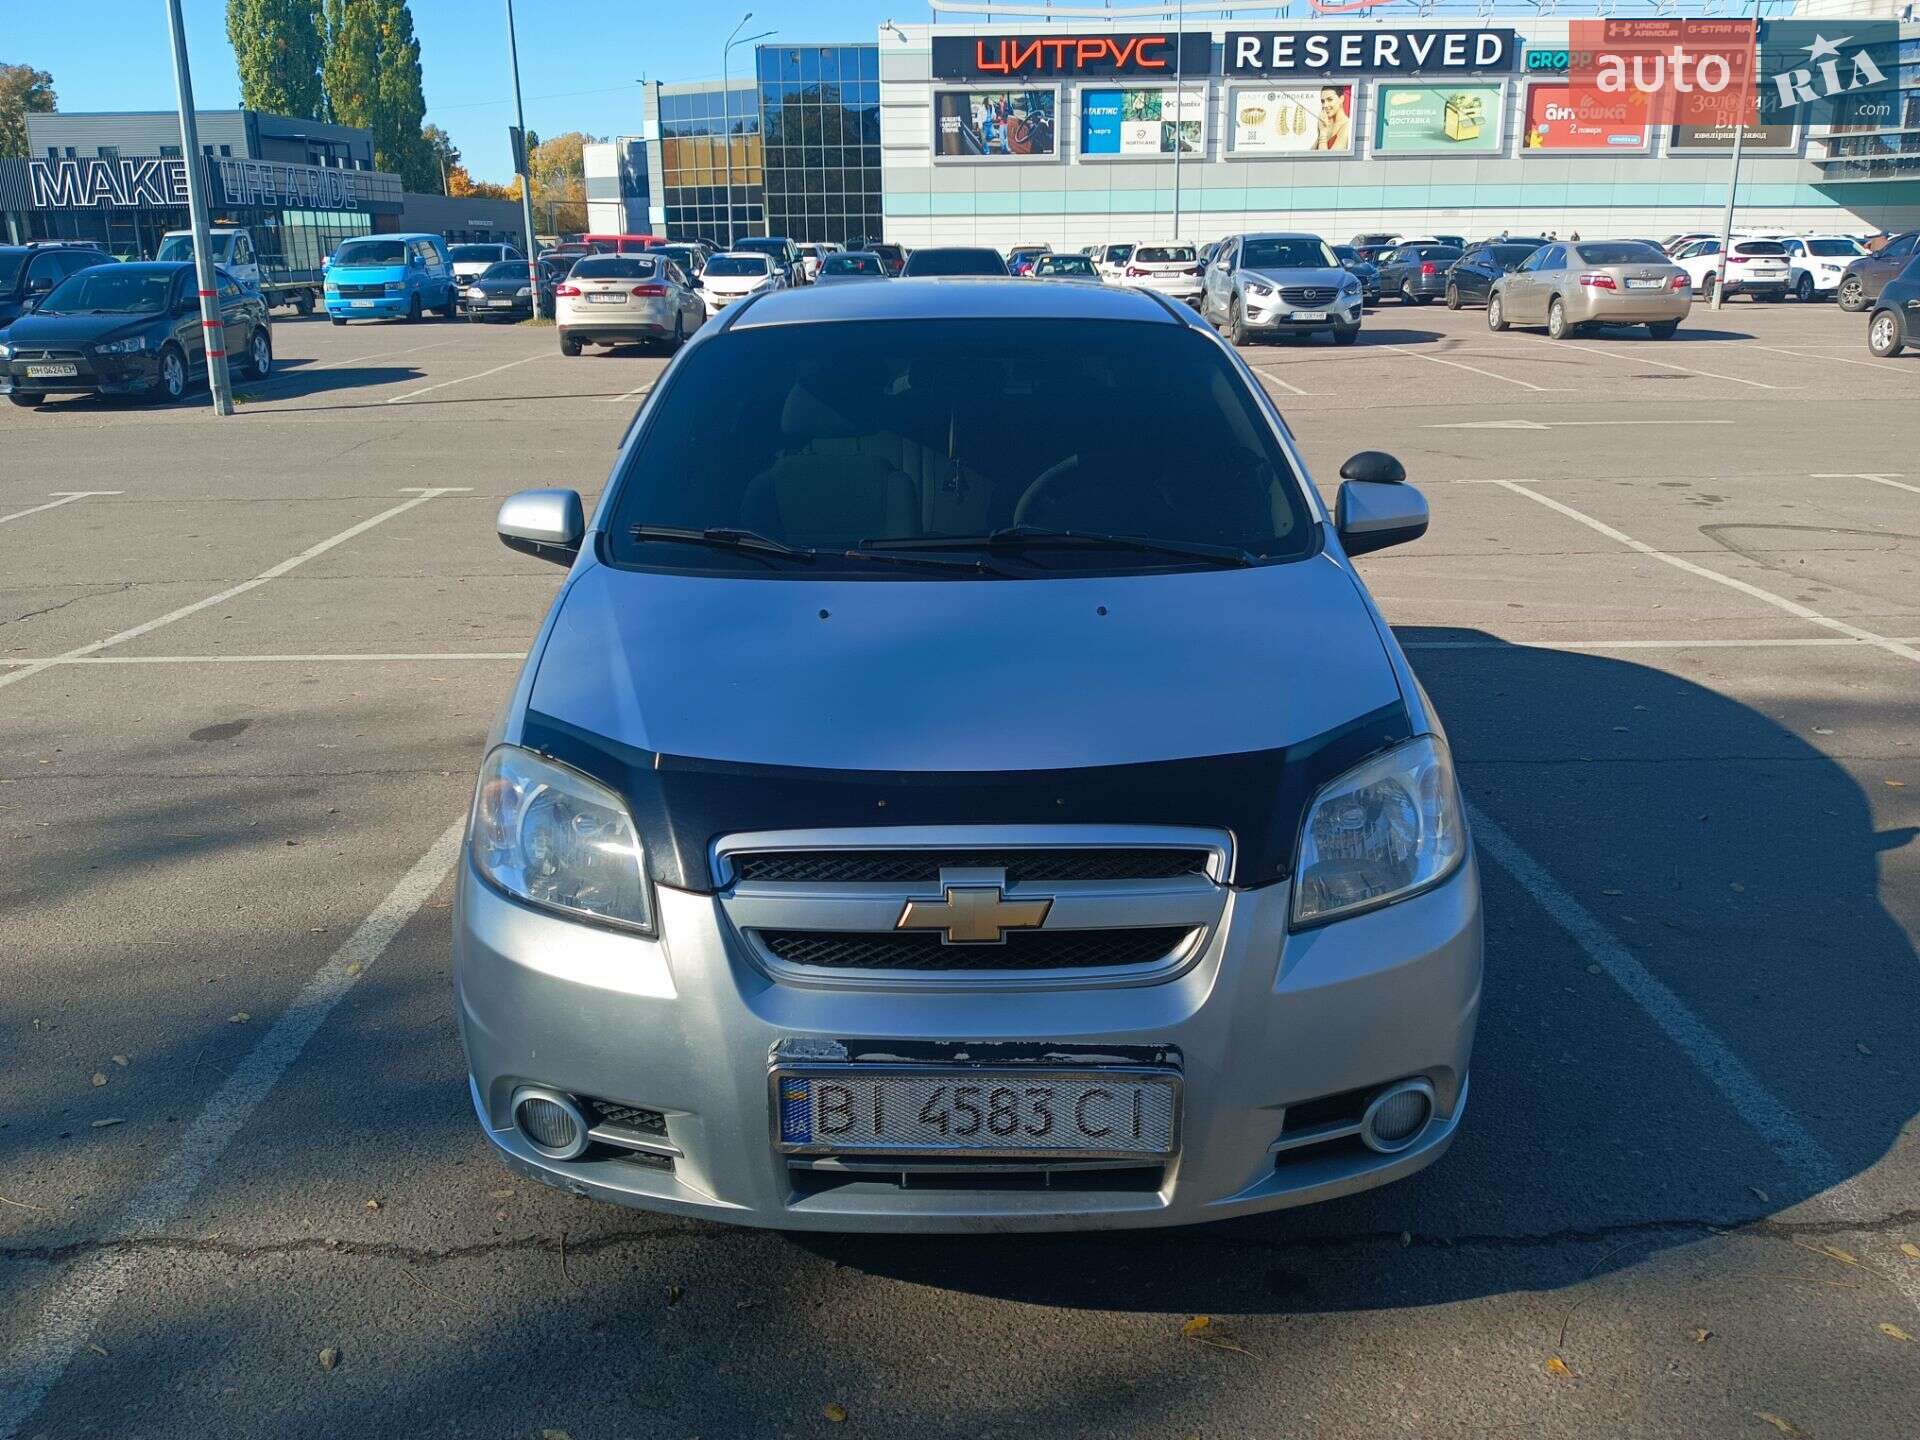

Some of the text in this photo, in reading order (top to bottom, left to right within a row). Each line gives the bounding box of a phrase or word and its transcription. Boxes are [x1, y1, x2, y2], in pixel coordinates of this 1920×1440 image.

[1633, 30, 1679, 38] ARMOUR
[1634, 22, 1670, 30] UNDER
[1688, 24, 1731, 34] G-STAR
[976, 37, 1167, 74] ЦИТРУС
[1235, 33, 1504, 69] RESERVED
[1528, 51, 1593, 68] CROPP
[1569, 124, 1577, 134] 2
[29, 159, 358, 210] MAKE LIFE A RIDE
[817, 1086, 1141, 1137] BI 4583 CI
